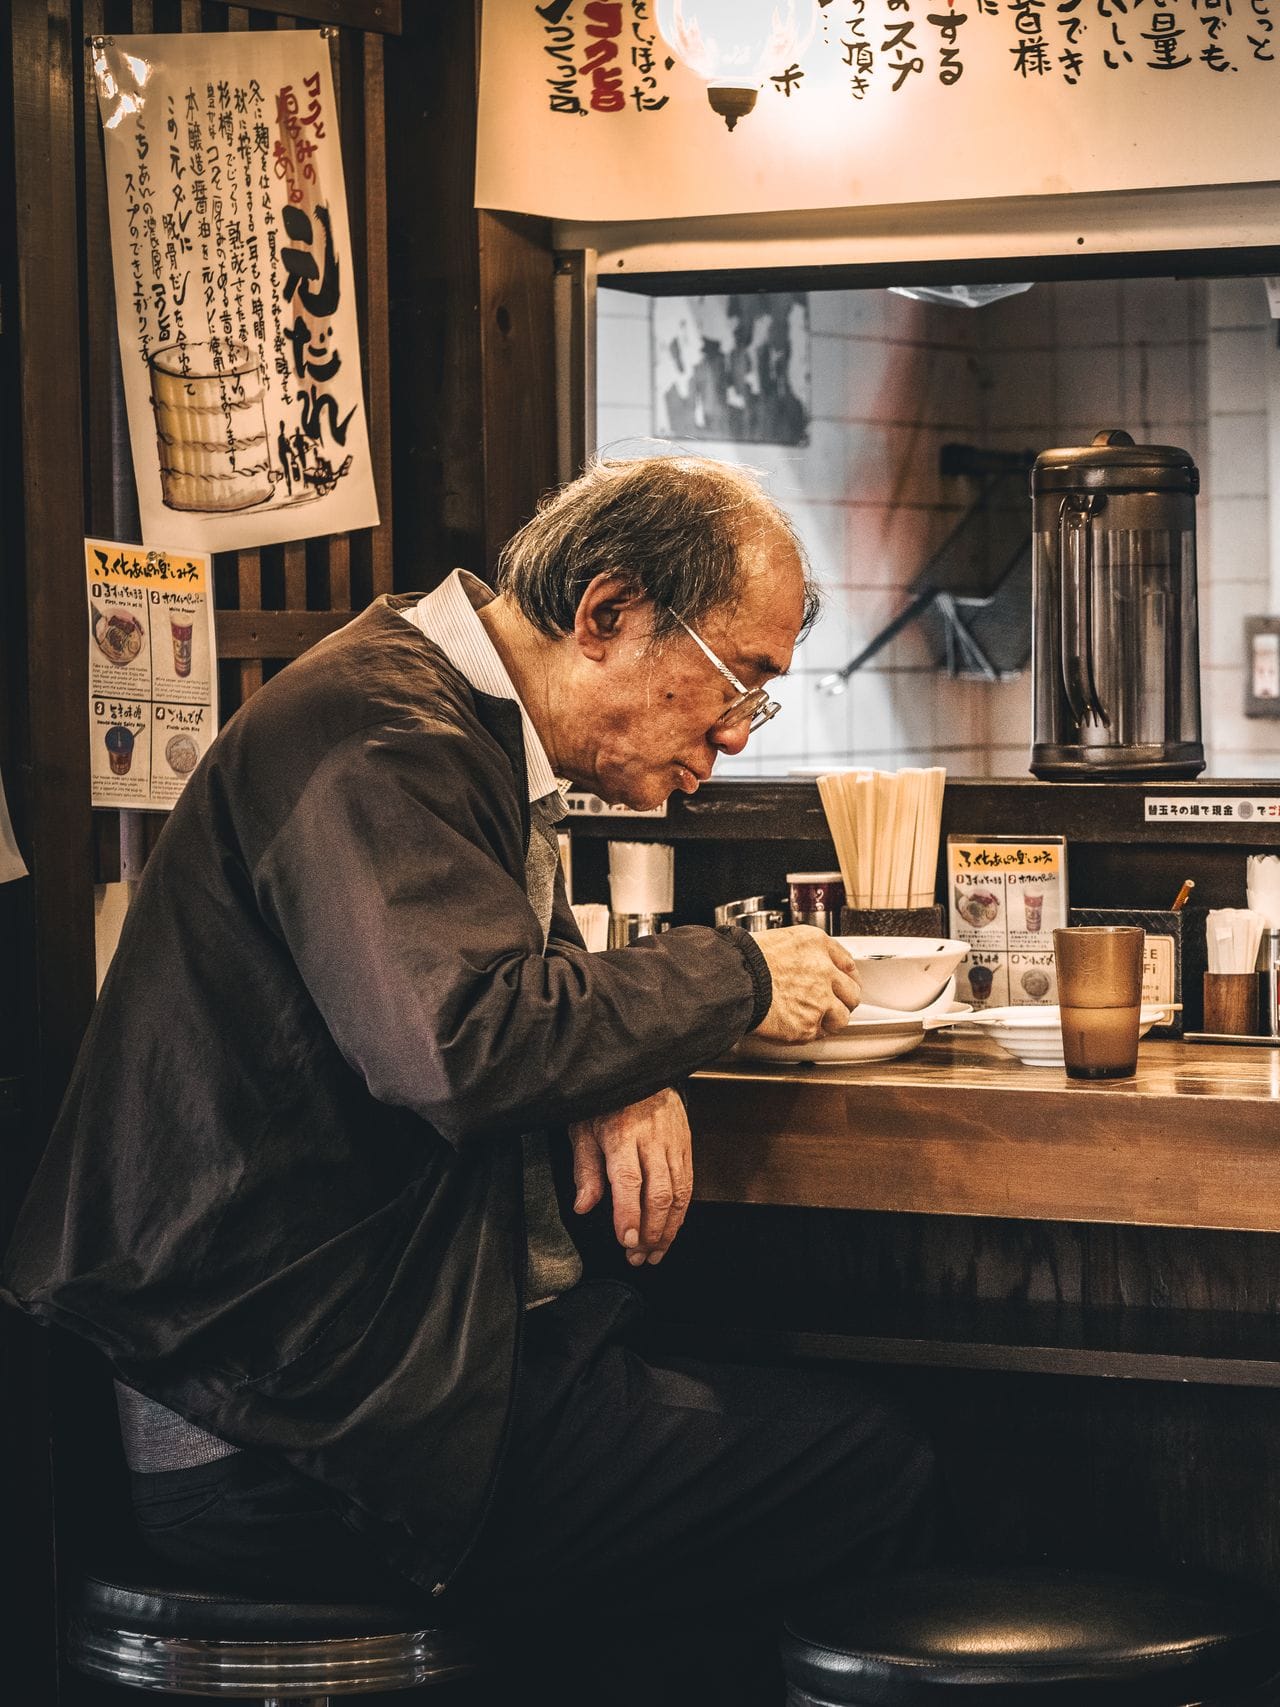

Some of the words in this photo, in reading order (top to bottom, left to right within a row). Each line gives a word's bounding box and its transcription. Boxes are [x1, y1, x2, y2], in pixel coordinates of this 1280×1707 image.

[927, 9, 968, 85] する
[1140, 0, 1192, 70] 量
[283, 200, 358, 447] 元だれ
